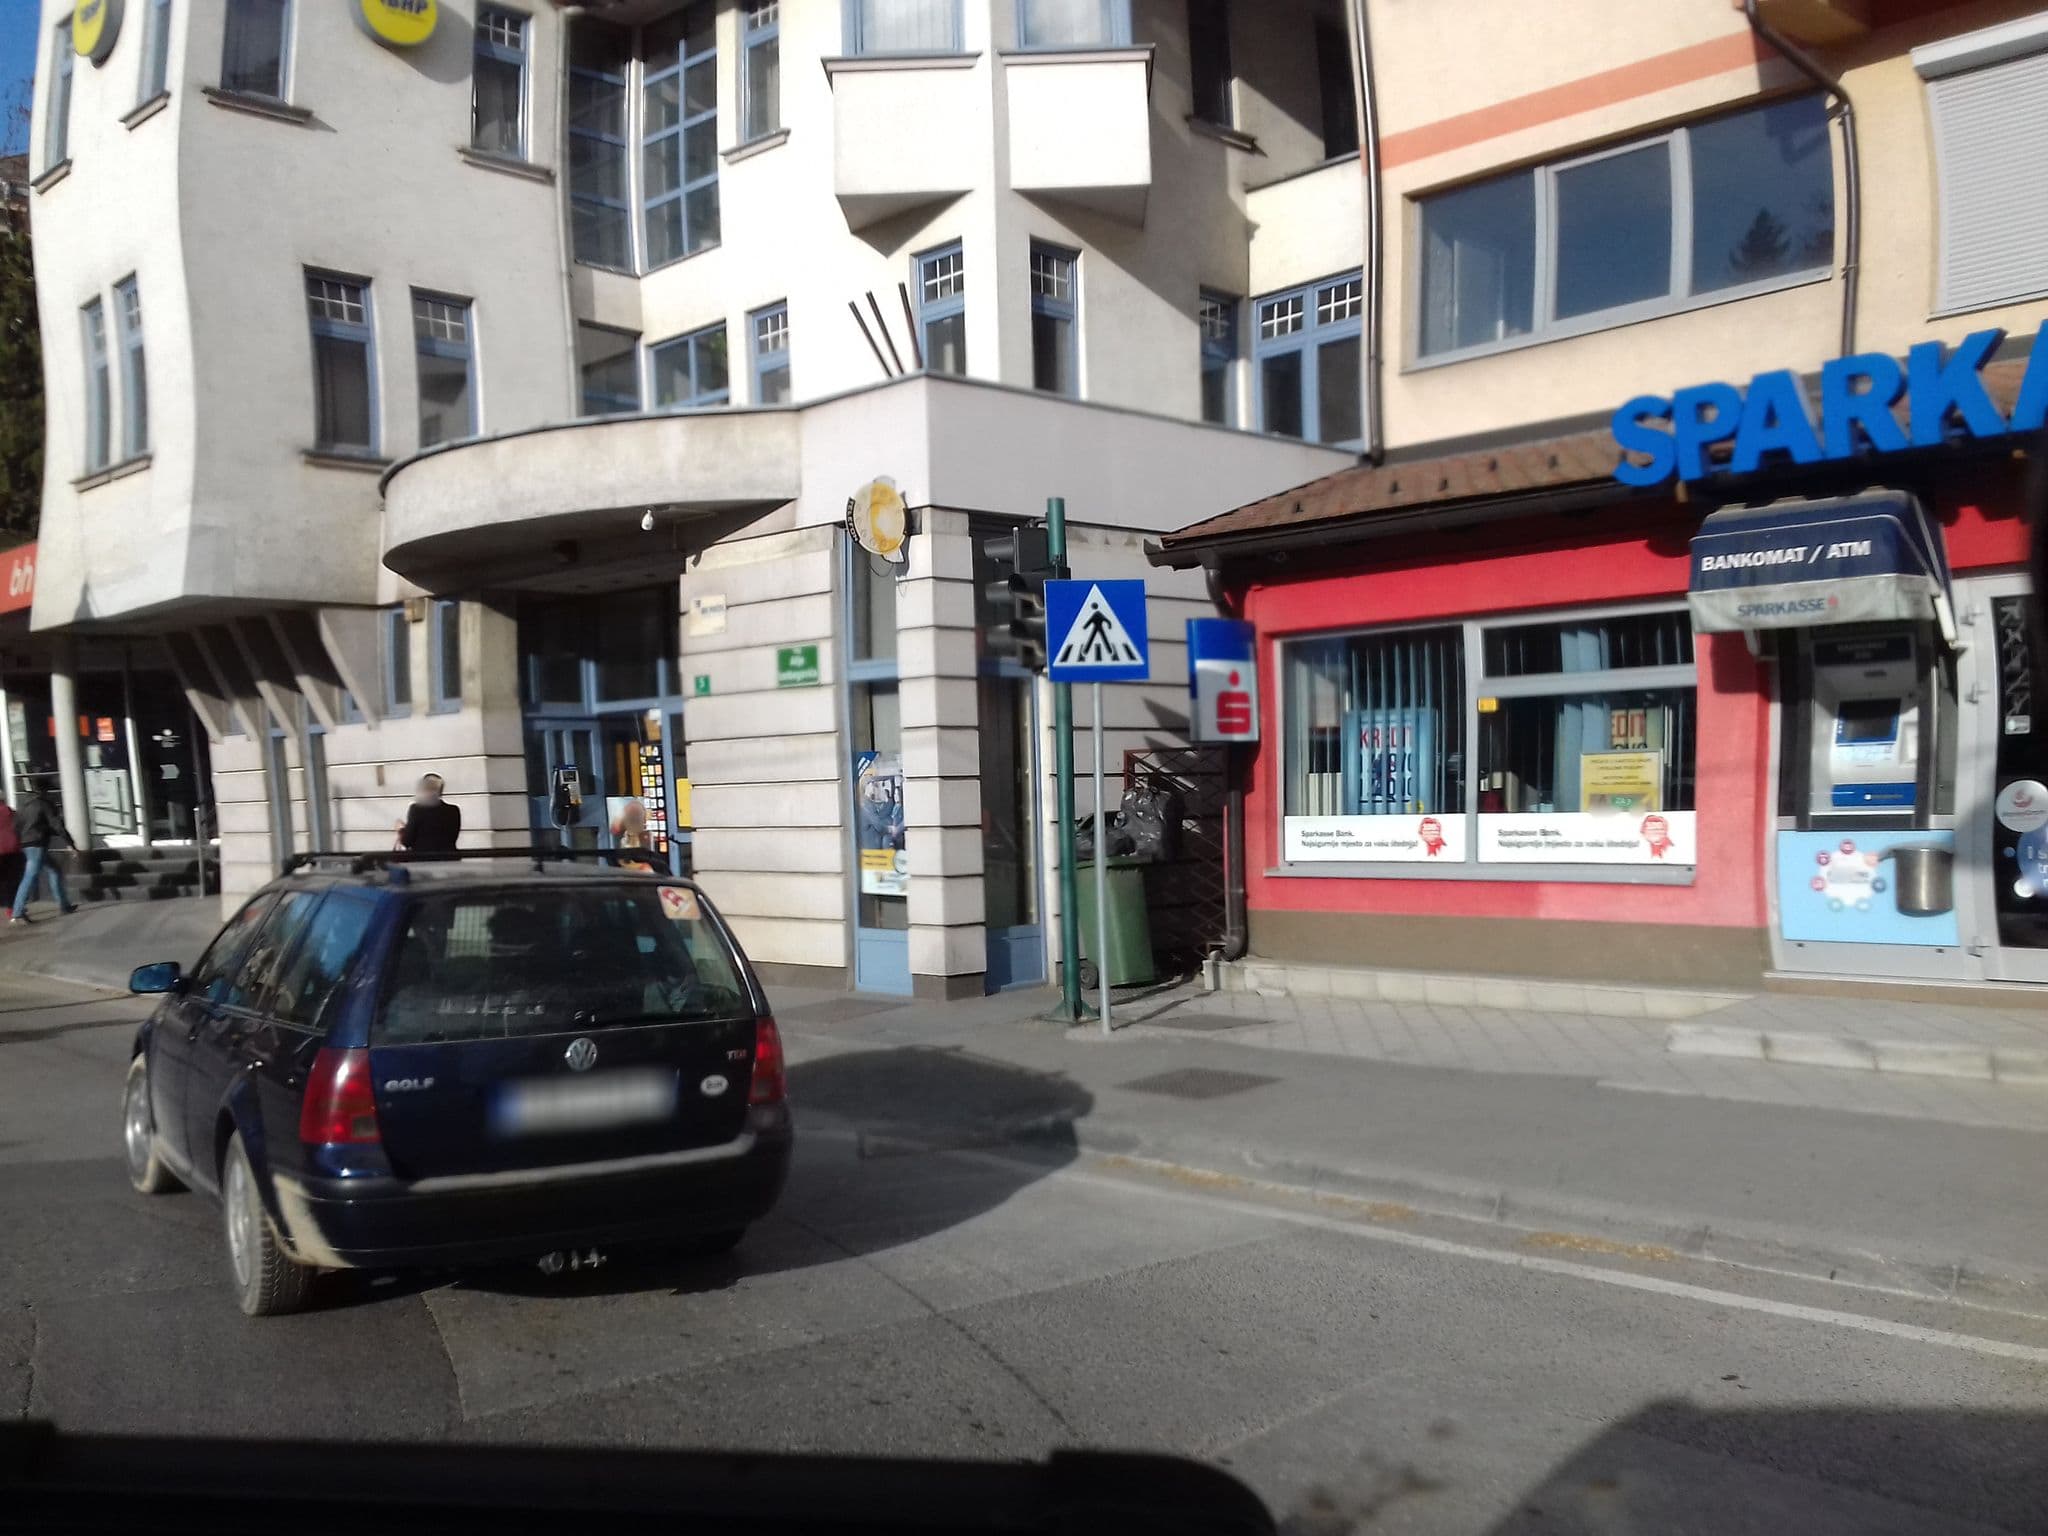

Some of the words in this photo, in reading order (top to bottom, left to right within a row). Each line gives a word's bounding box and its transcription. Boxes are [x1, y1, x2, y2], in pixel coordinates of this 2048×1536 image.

[1701, 546, 1808, 572] BANKOMAT
[1808, 545, 1824, 564] /
[1826, 540, 1872, 560] ATM
[1737, 598, 1826, 617] SPARKASSE
[1301, 830, 1335, 838] Sparkasse
[727, 1049, 747, 1061] TDI
[384, 1077, 436, 1092] GOLF
